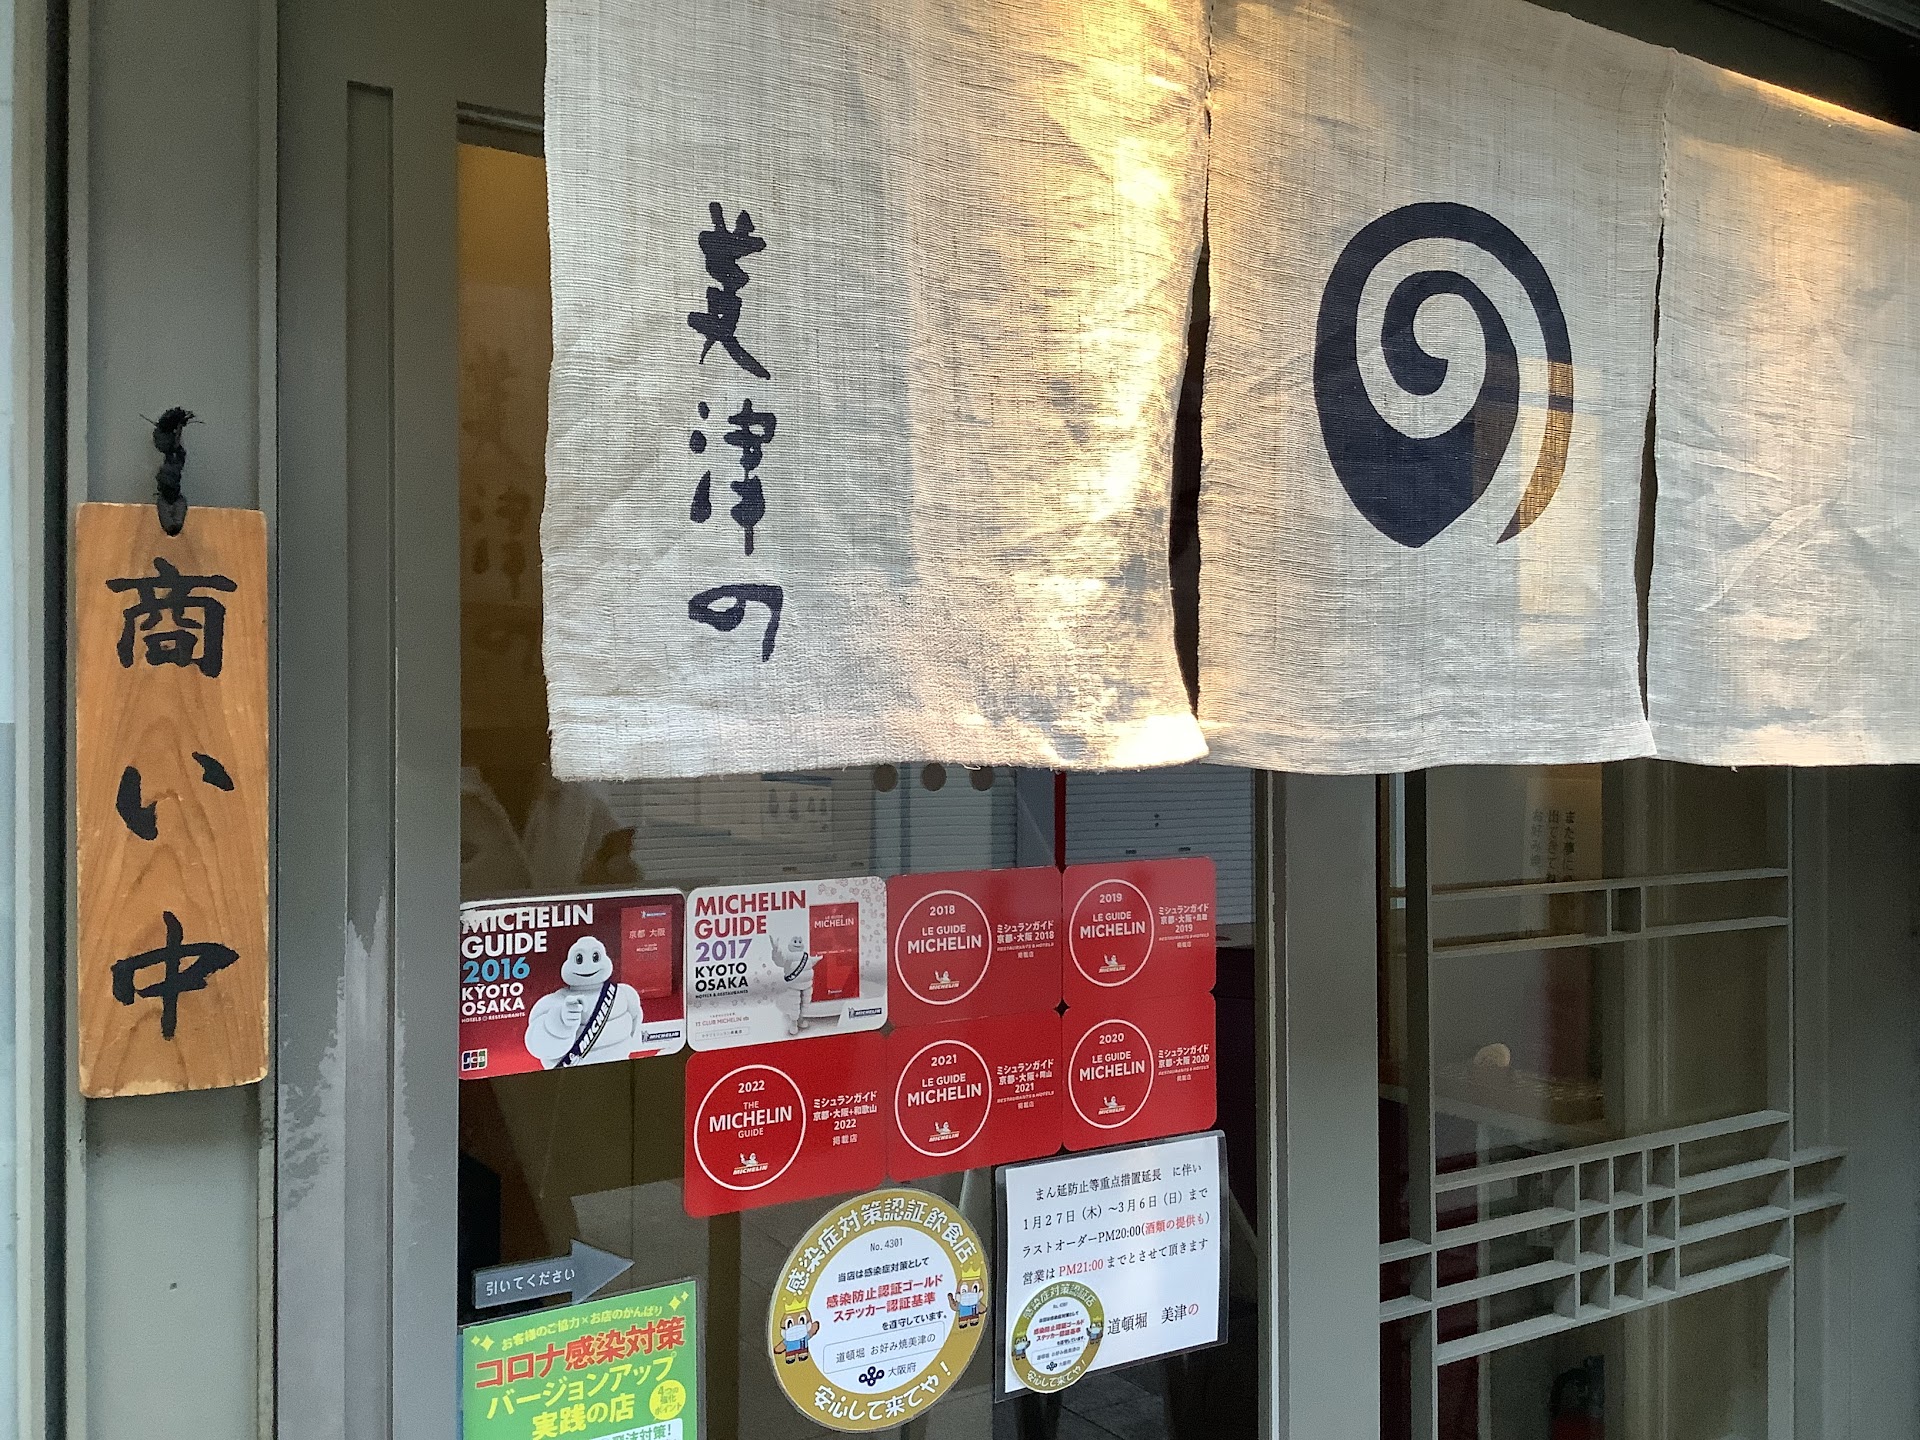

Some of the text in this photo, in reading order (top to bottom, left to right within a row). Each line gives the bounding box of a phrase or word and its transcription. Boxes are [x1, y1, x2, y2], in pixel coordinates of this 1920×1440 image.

[687, 201, 783, 662] 美津の
[106, 556, 239, 1041] 商い中
[694, 889, 806, 917] MICHELIN
[1100, 893, 1122, 903] 2019
[460, 903, 594, 934] MICHELIN
[930, 905, 955, 916] 2018
[1093, 911, 1132, 922] LE GUIDE
[1158, 903, 1209, 916] ミシュランガイド
[694, 915, 767, 940] GUIDE
[814, 917, 855, 929] MICHELIN
[922, 924, 966, 936] LE GUIDE
[997, 920, 1054, 933] ミシュランガイド
[1080, 921, 1146, 939] MICHELIN
[1175, 924, 1193, 934] 2019
[629, 927, 666, 939] 京都 大阪
[1035, 931, 1054, 941] 2018
[461, 930, 547, 959] GUIDE
[695, 938, 753, 963] 2017
[907, 934, 982, 954] MICHELIN
[462, 957, 530, 984] 2016
[695, 962, 748, 979] KYOTO
[461, 982, 524, 1001] KYOTO
[695, 975, 749, 993] OSAKA
[461, 997, 525, 1016] OSAKA
[578, 984, 617, 1054] MICHELIN
[702, 1016, 742, 1026] CLUB MICHELIN
[649, 1031, 680, 1040] MICHELIN
[1099, 1033, 1124, 1044] 2020
[463, 1050, 487, 1069] JCB
[1092, 1050, 1131, 1064] LE GUIDE
[1158, 1043, 1209, 1059] ミシュランガイド
[1192, 1054, 1210, 1064] 2020
[931, 1054, 957, 1067] 2021
[997, 1058, 1054, 1075] ミシュランガイド
[1079, 1060, 1145, 1082] MICHELIN
[738, 1080, 765, 1094] 2022
[922, 1073, 966, 1088] LE GUIDE
[1014, 1082, 1034, 1093] 2021
[813, 1090, 877, 1109] ミシュランガイド
[907, 1082, 982, 1107] MICHELIN
[743, 1100, 759, 1110] THE
[709, 1105, 793, 1133] MICHELIN
[833, 1119, 857, 1131] 2022
[738, 1127, 764, 1139] GUIDE
[732, 1164, 768, 1175] MICHELIN
[1035, 1163, 1202, 1201] まん延防止等重点措置延長 に伴い
[786, 1197, 978, 1295] 感染症対策認証飲食店
[838, 1257, 929, 1283] 当店は感染症対策として
[1058, 1259, 1104, 1277] PM21:00
[485, 1268, 576, 1297] 引いてください
[826, 1273, 944, 1309] 感染防止認証ゴールド
[833, 1291, 936, 1323] ステッカー認証基準
[882, 1311, 948, 1331] を遵守しています。
[1107, 1303, 1199, 1336] 道頓堀 美津の
[475, 1316, 685, 1389] コロナ感染対策
[836, 1333, 936, 1364] 道頓堀 お好み焼美津の
[887, 1362, 917, 1378] 大阪府
[486, 1351, 677, 1420] バージョンアップ
[531, 1393, 636, 1440] 実践の店
[655, 1402, 682, 1415] ポイント
